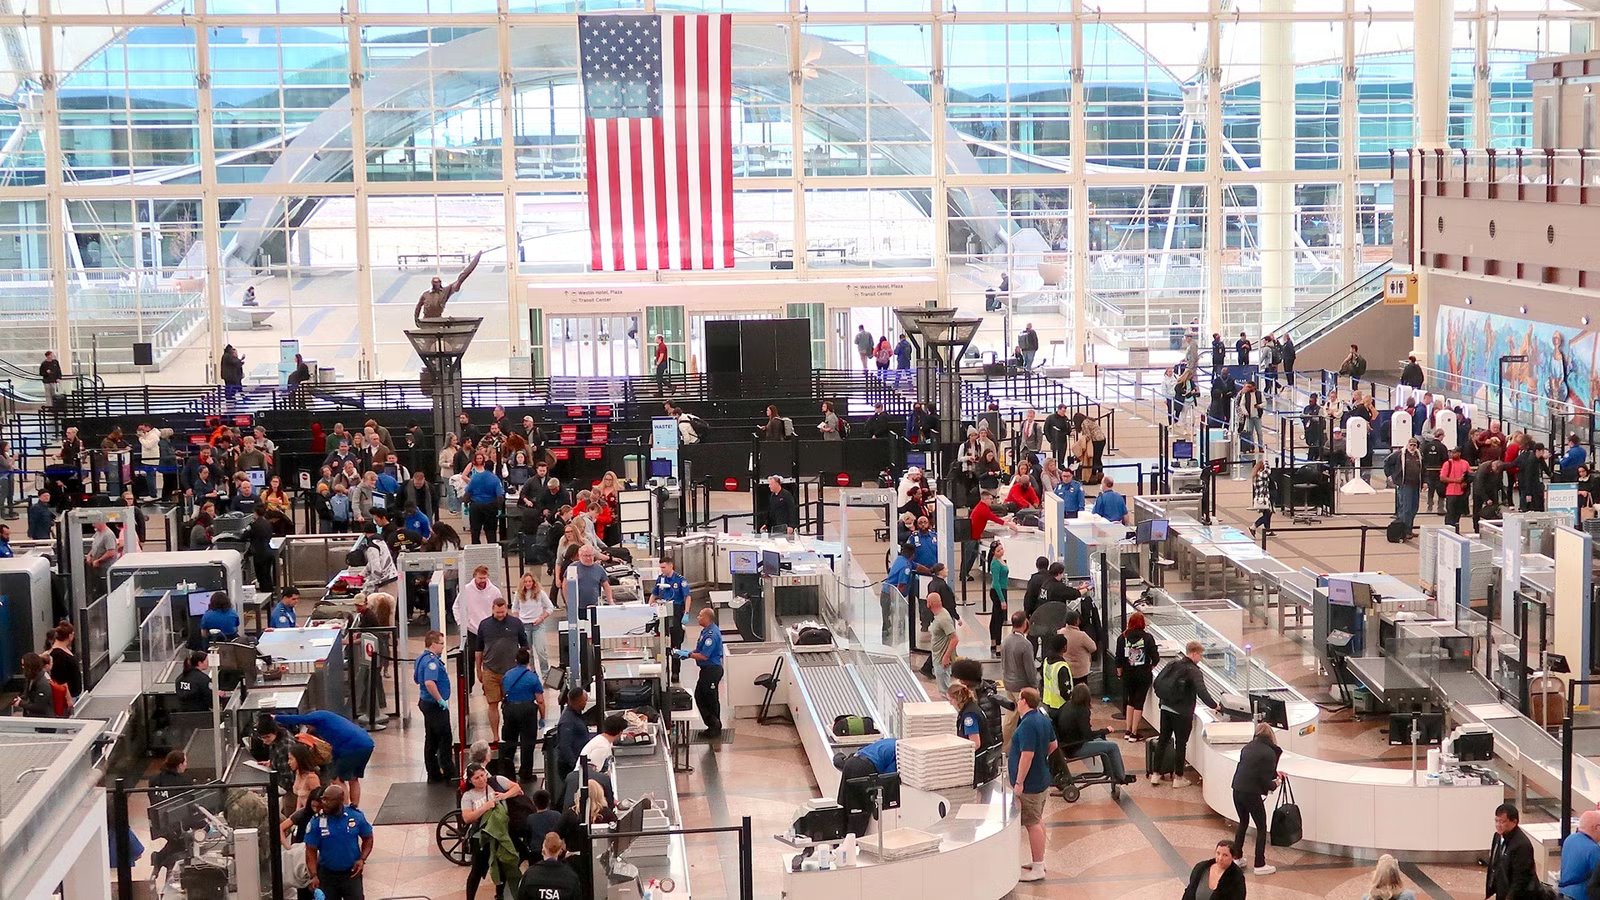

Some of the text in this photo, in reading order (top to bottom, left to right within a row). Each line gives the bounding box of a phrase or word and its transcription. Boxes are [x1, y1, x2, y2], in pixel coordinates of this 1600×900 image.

[878, 494, 889, 502] 10
[180, 681, 191, 690] TSA
[538, 888, 560, 900] TSA
